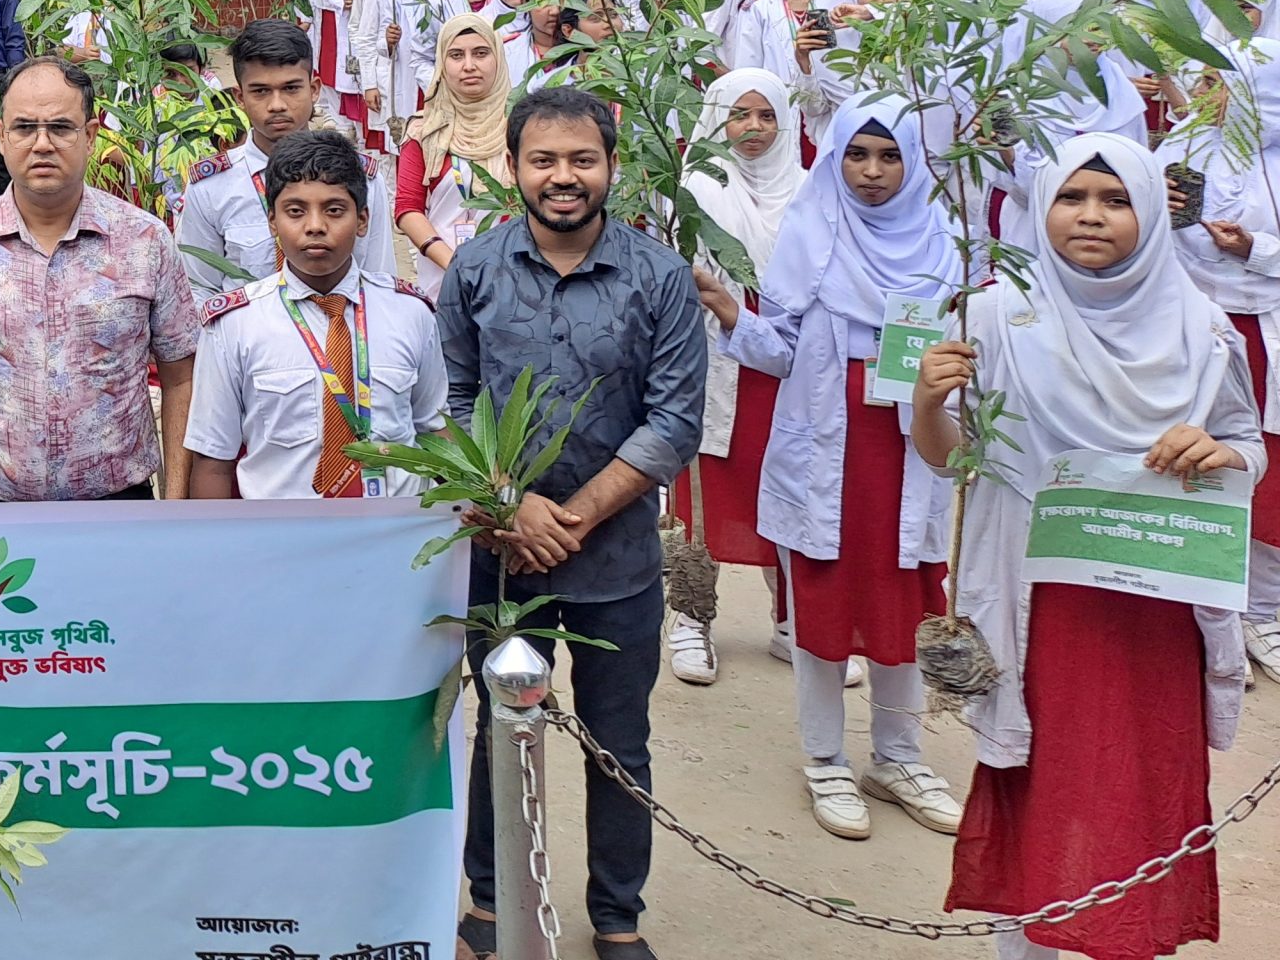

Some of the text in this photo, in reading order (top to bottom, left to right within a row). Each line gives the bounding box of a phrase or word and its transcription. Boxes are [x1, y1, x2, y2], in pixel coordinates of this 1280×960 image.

[906, 335, 926, 350] যে
[1099, 508, 1166, 527] আজকের
[1081, 522, 1144, 542] আগামীর
[50, 620, 116, 651] পৃথিবী,
[34, 651, 107, 674] ভবিষ্যৎ
